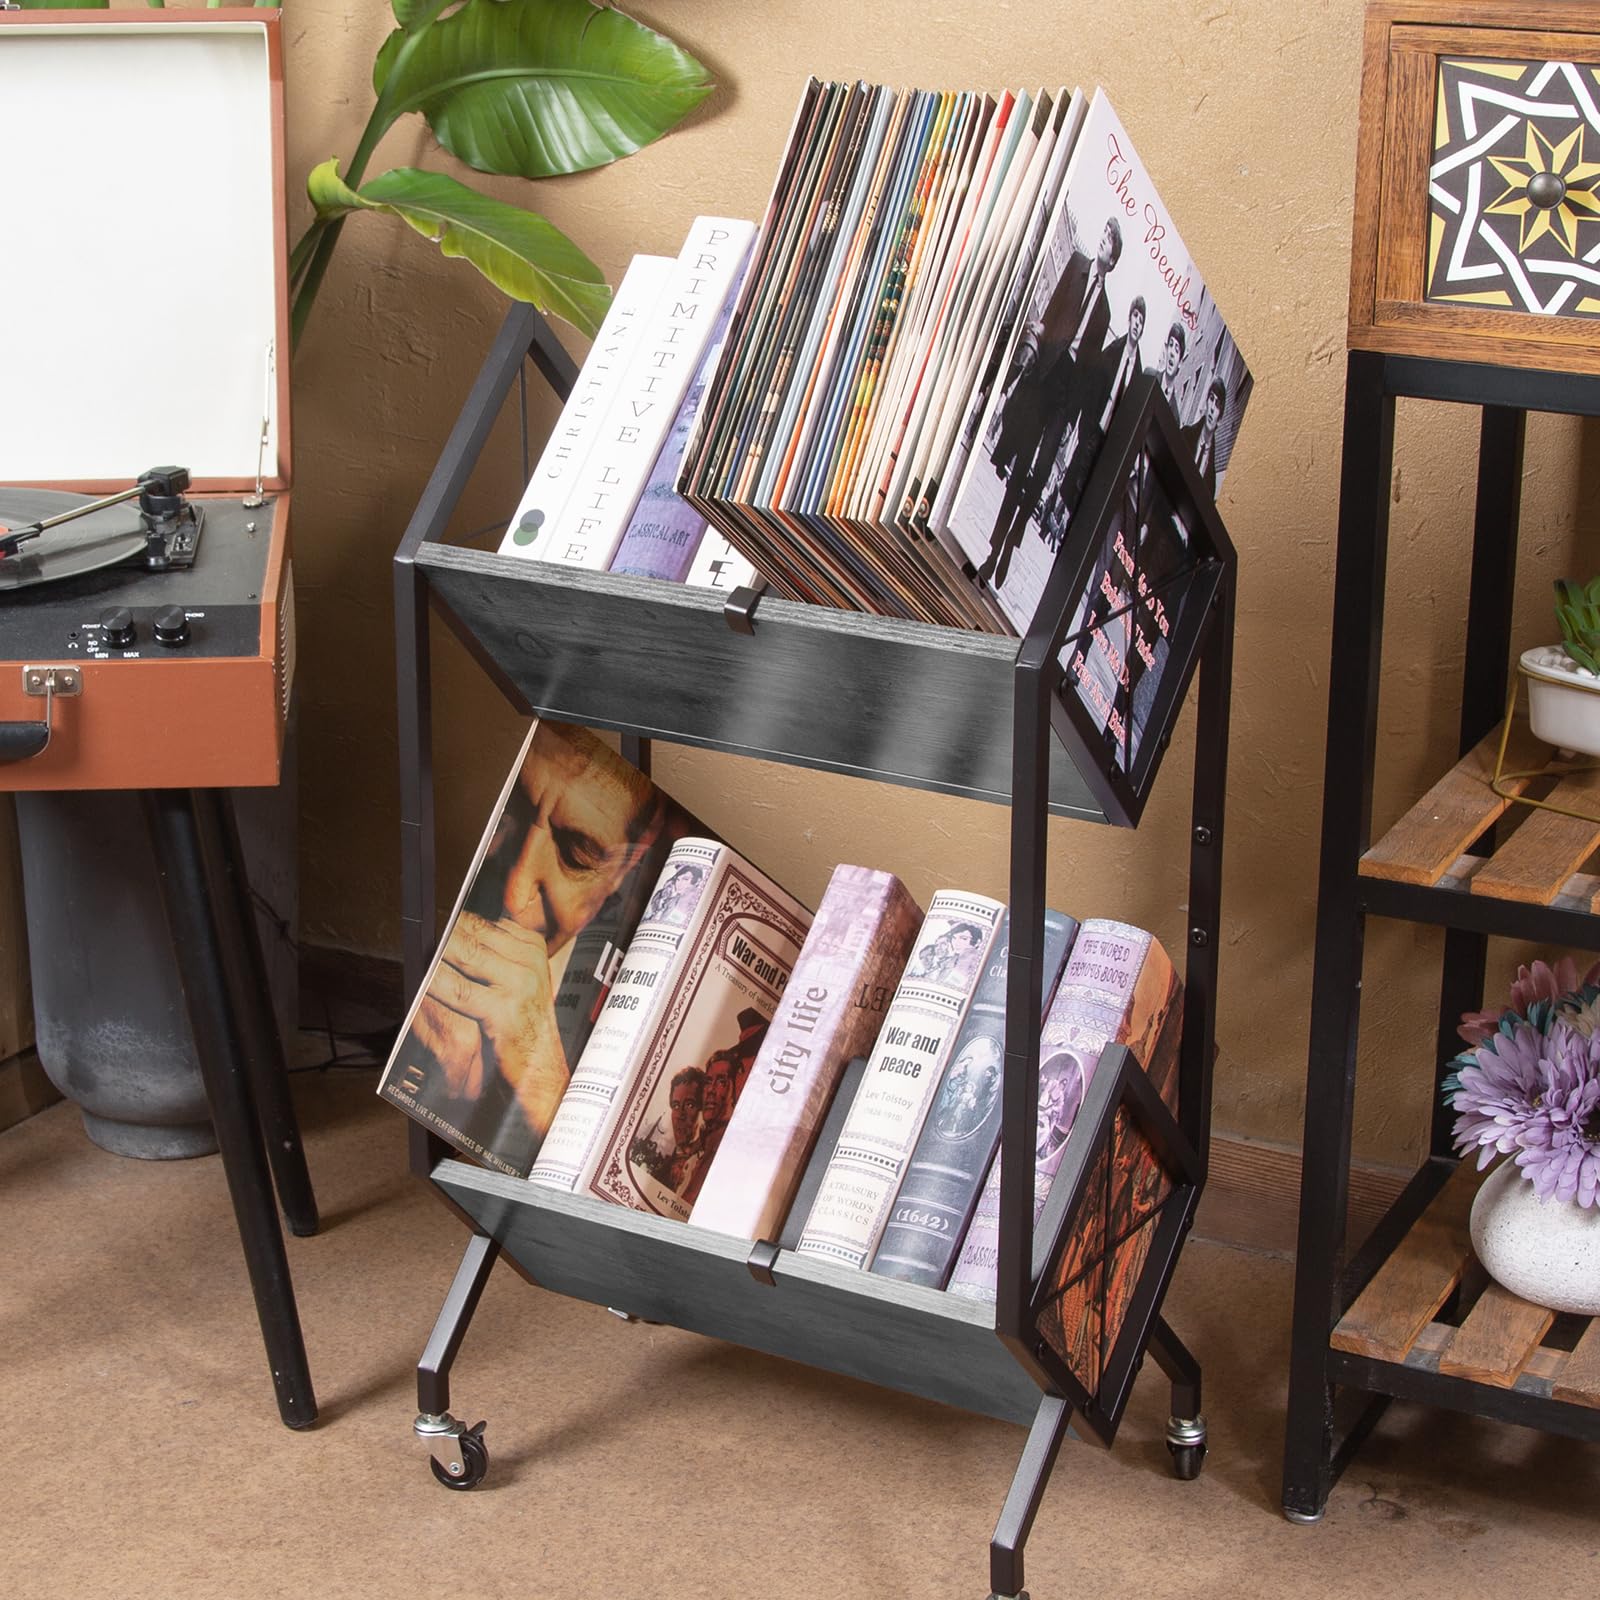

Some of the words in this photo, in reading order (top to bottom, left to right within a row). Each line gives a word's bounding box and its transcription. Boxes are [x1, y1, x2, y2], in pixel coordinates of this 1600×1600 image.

[1106, 133, 1137, 217] The
[1144, 203, 1200, 331] Beatles
[615, 229, 730, 444] PRIMITIVE
[547, 306, 637, 479] CHRISTIANE
[562, 465, 621, 562] LIFE
[669, 530, 692, 548] ART
[615, 967, 634, 985] War
[632, 969, 659, 988] and
[719, 965, 749, 995] Treasury
[731, 935, 757, 968] War
[753, 957, 780, 988] and
[606, 993, 640, 1012] peace
[787, 986, 828, 1034] life
[885, 1026, 912, 1047] War
[911, 1033, 941, 1055] and
[768, 1041, 811, 1095] city
[878, 1056, 922, 1079] peace
[387, 1083, 417, 1109] RECORDED
[415, 1103, 429, 1119] LIVE
[427, 1111, 436, 1122] AT
[434, 1115, 476, 1150] PERFORMANCES
[474, 1143, 484, 1155] OF
[880, 1091, 914, 1111] Tolstoy
[895, 1207, 949, 1231] (1642)
